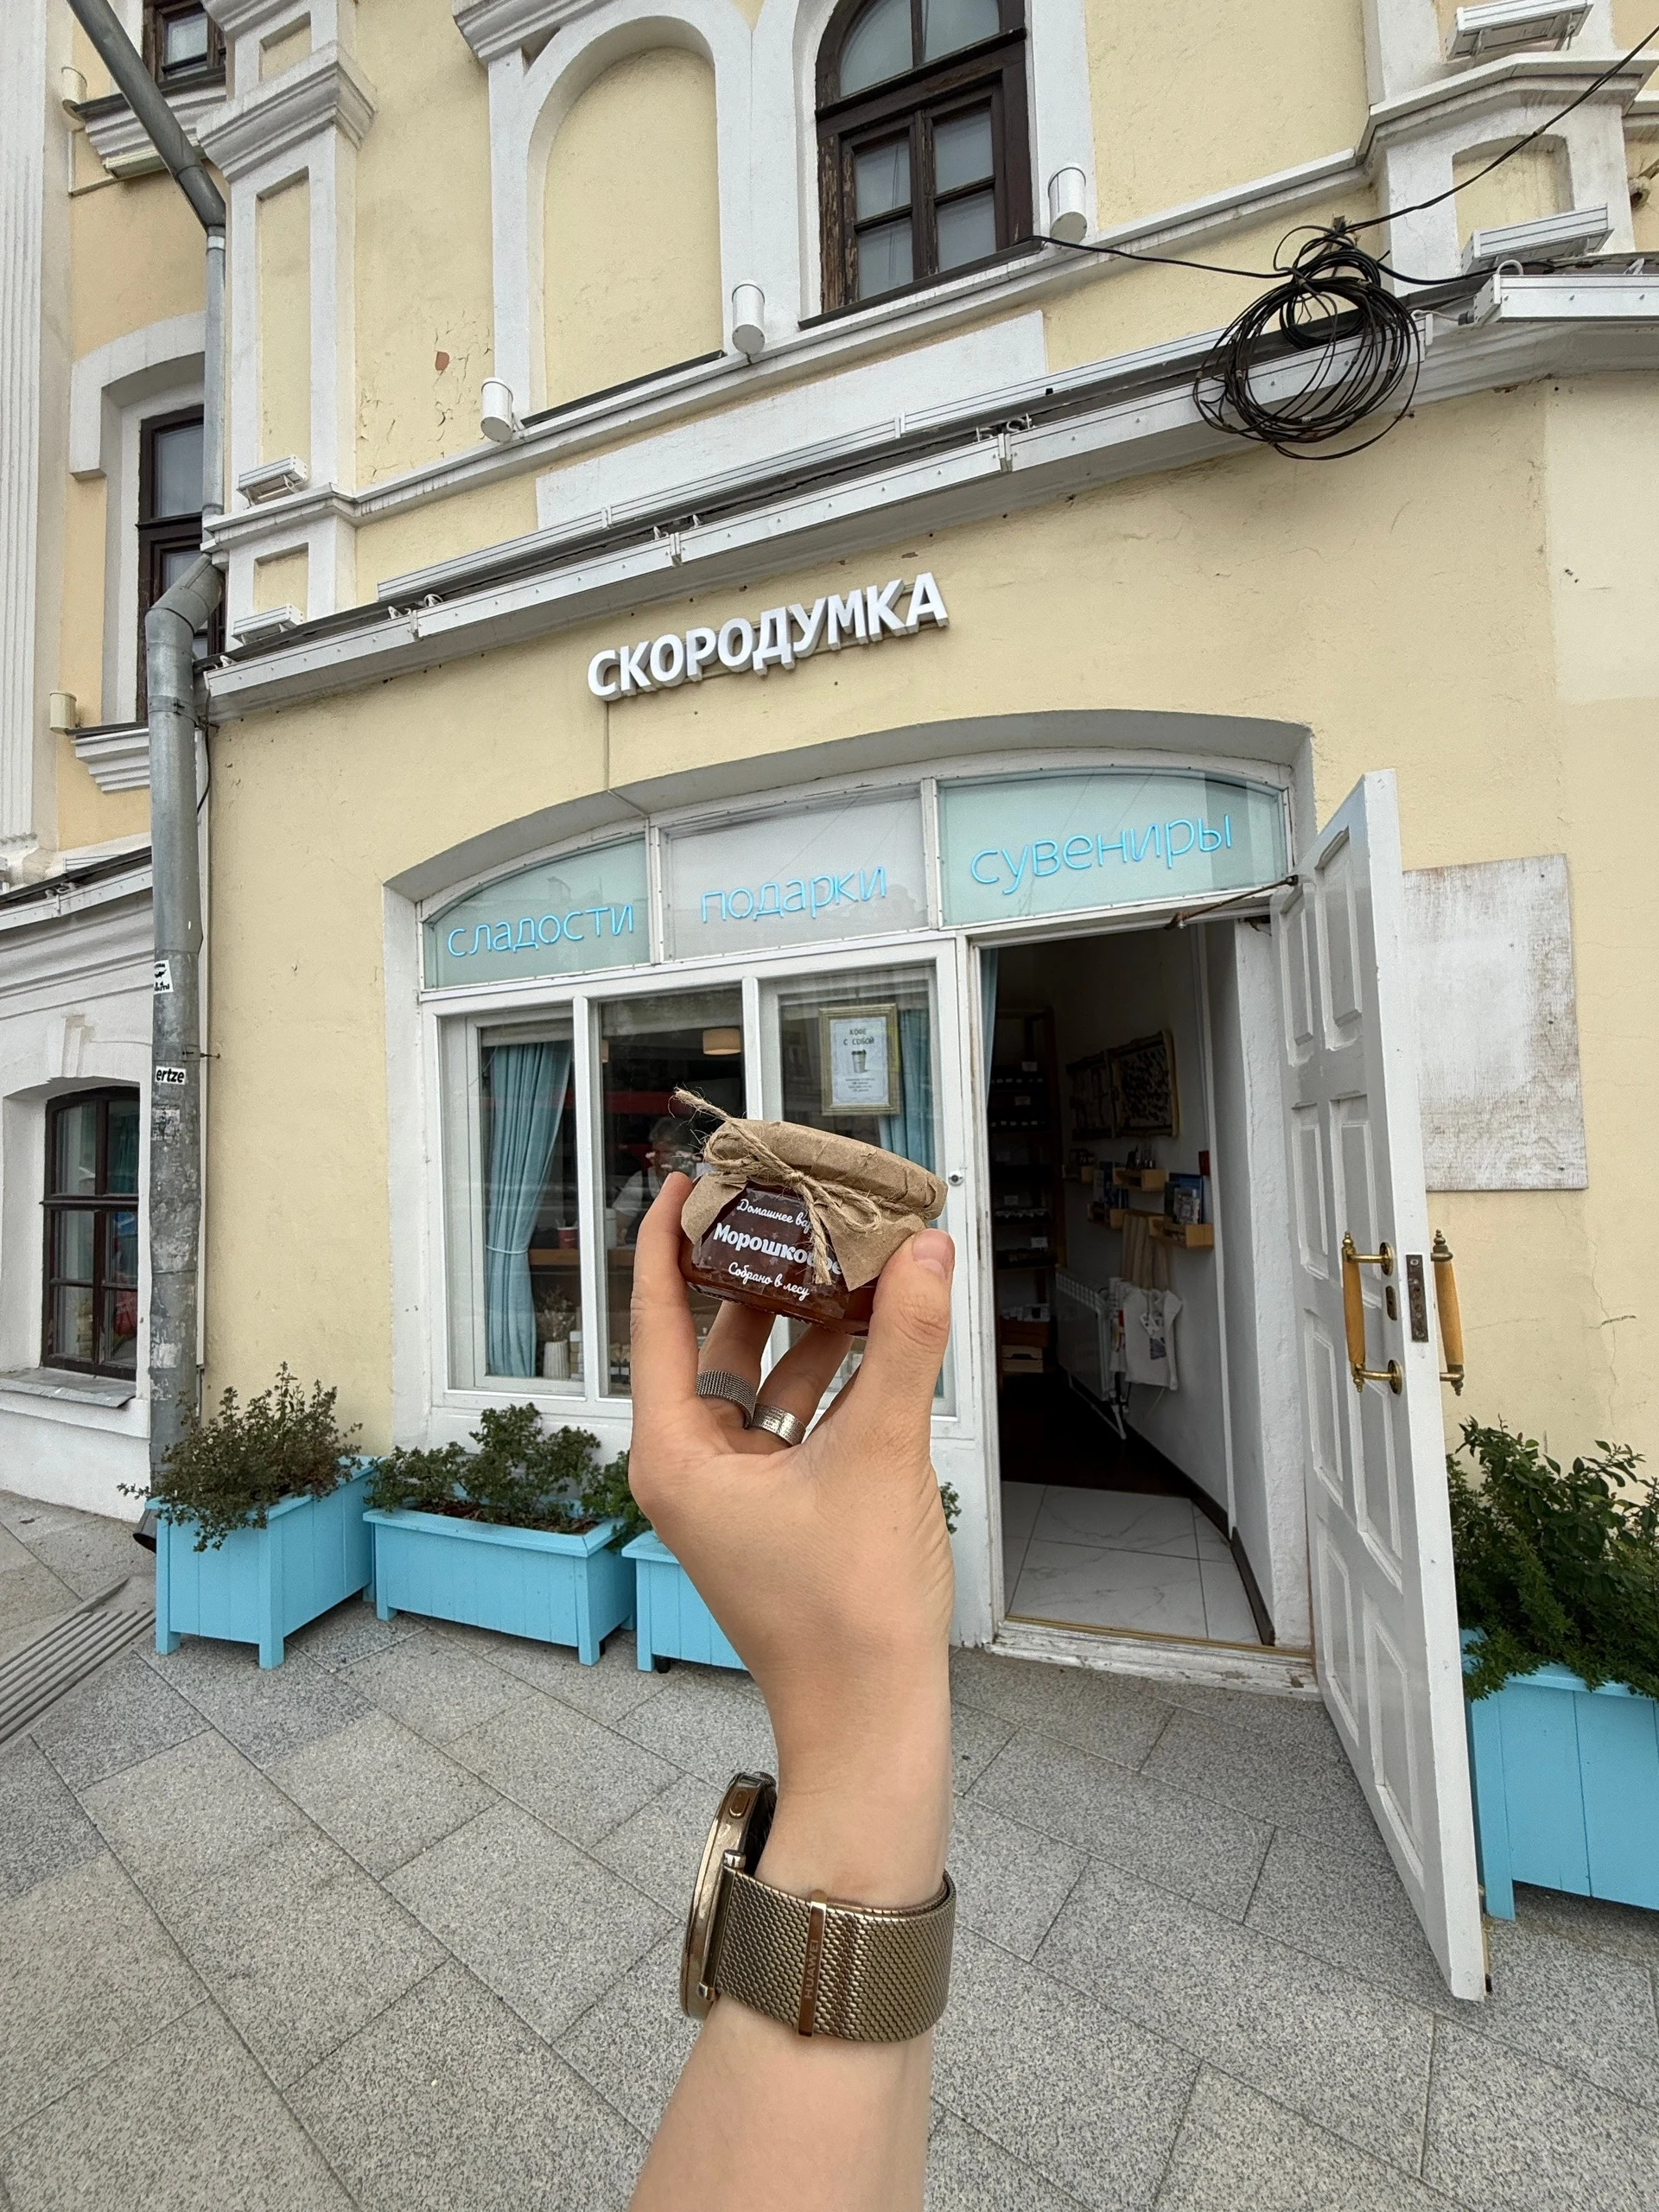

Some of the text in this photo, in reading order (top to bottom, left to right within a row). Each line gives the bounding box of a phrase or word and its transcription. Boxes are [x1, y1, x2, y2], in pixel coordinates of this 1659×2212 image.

[588, 572, 949, 701] СКОРОДУМКА
[970, 815, 1232, 894] сувениры
[700, 867, 887, 922] подарки
[448, 903, 634, 957] сладости
[852, 1036, 874, 1046] СОБОЙ
[156, 1068, 185, 1084] ertze
[736, 1198, 794, 1224] Домашнее
[728, 1262, 810, 1301] Собрано в лесу
[804, 1939, 819, 1999] HUAWEI
